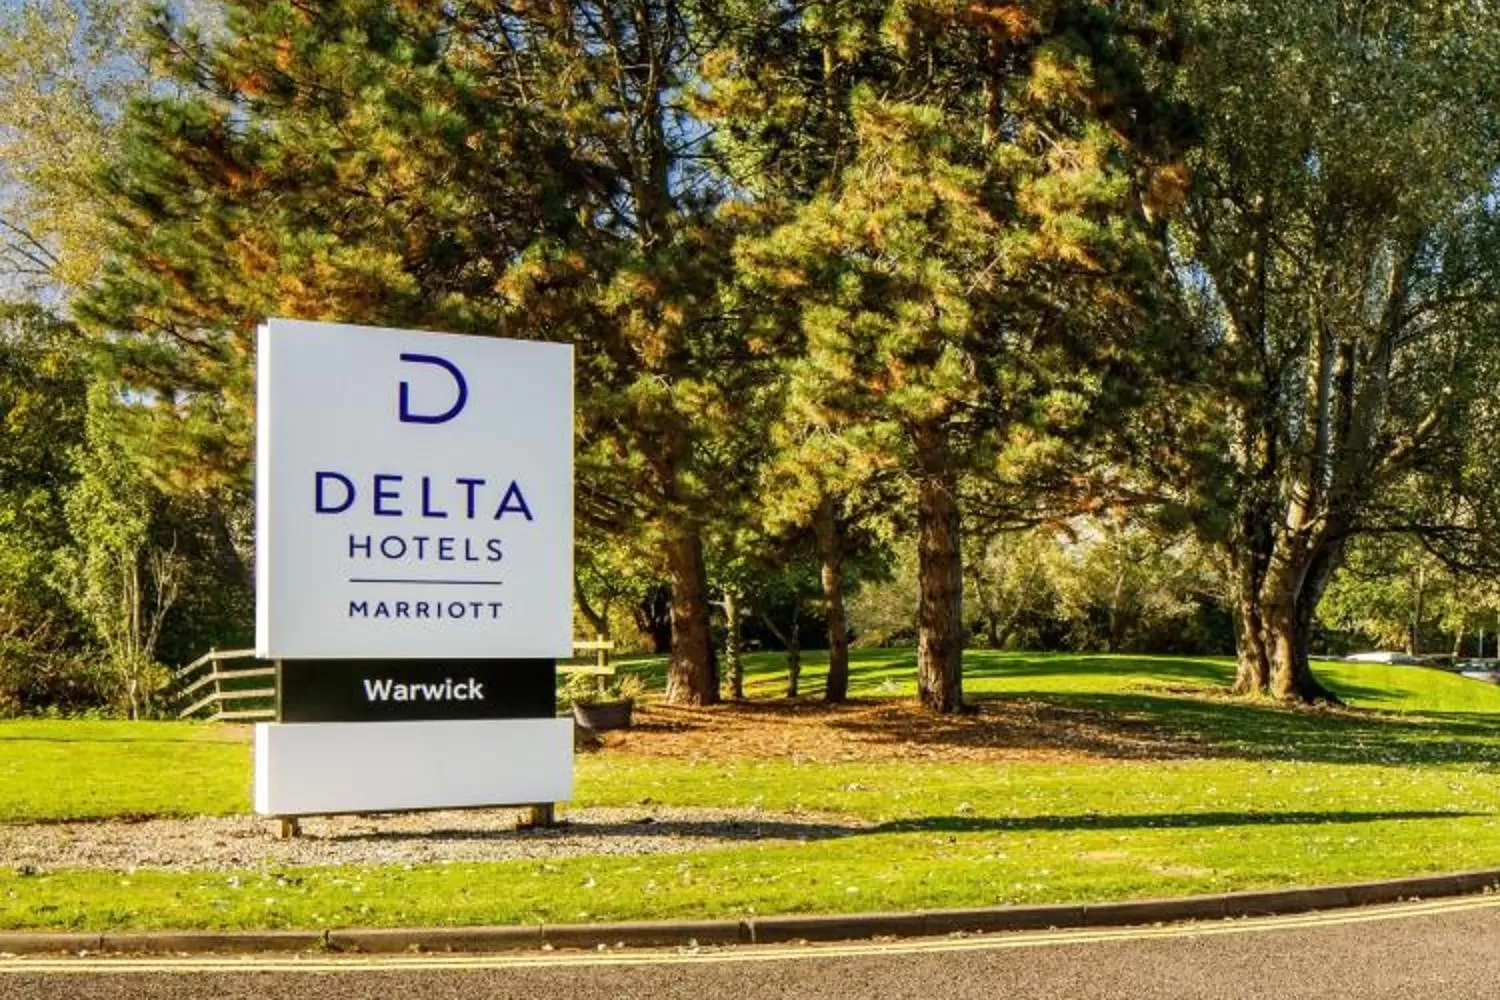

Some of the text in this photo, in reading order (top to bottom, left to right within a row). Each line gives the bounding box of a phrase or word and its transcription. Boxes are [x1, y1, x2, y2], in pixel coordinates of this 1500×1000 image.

[399, 353, 468, 425] D
[314, 470, 534, 521] DELTA
[348, 534, 504, 562] HOTELS
[348, 600, 503, 619] MARRIOTT
[363, 678, 484, 701] Warwick
